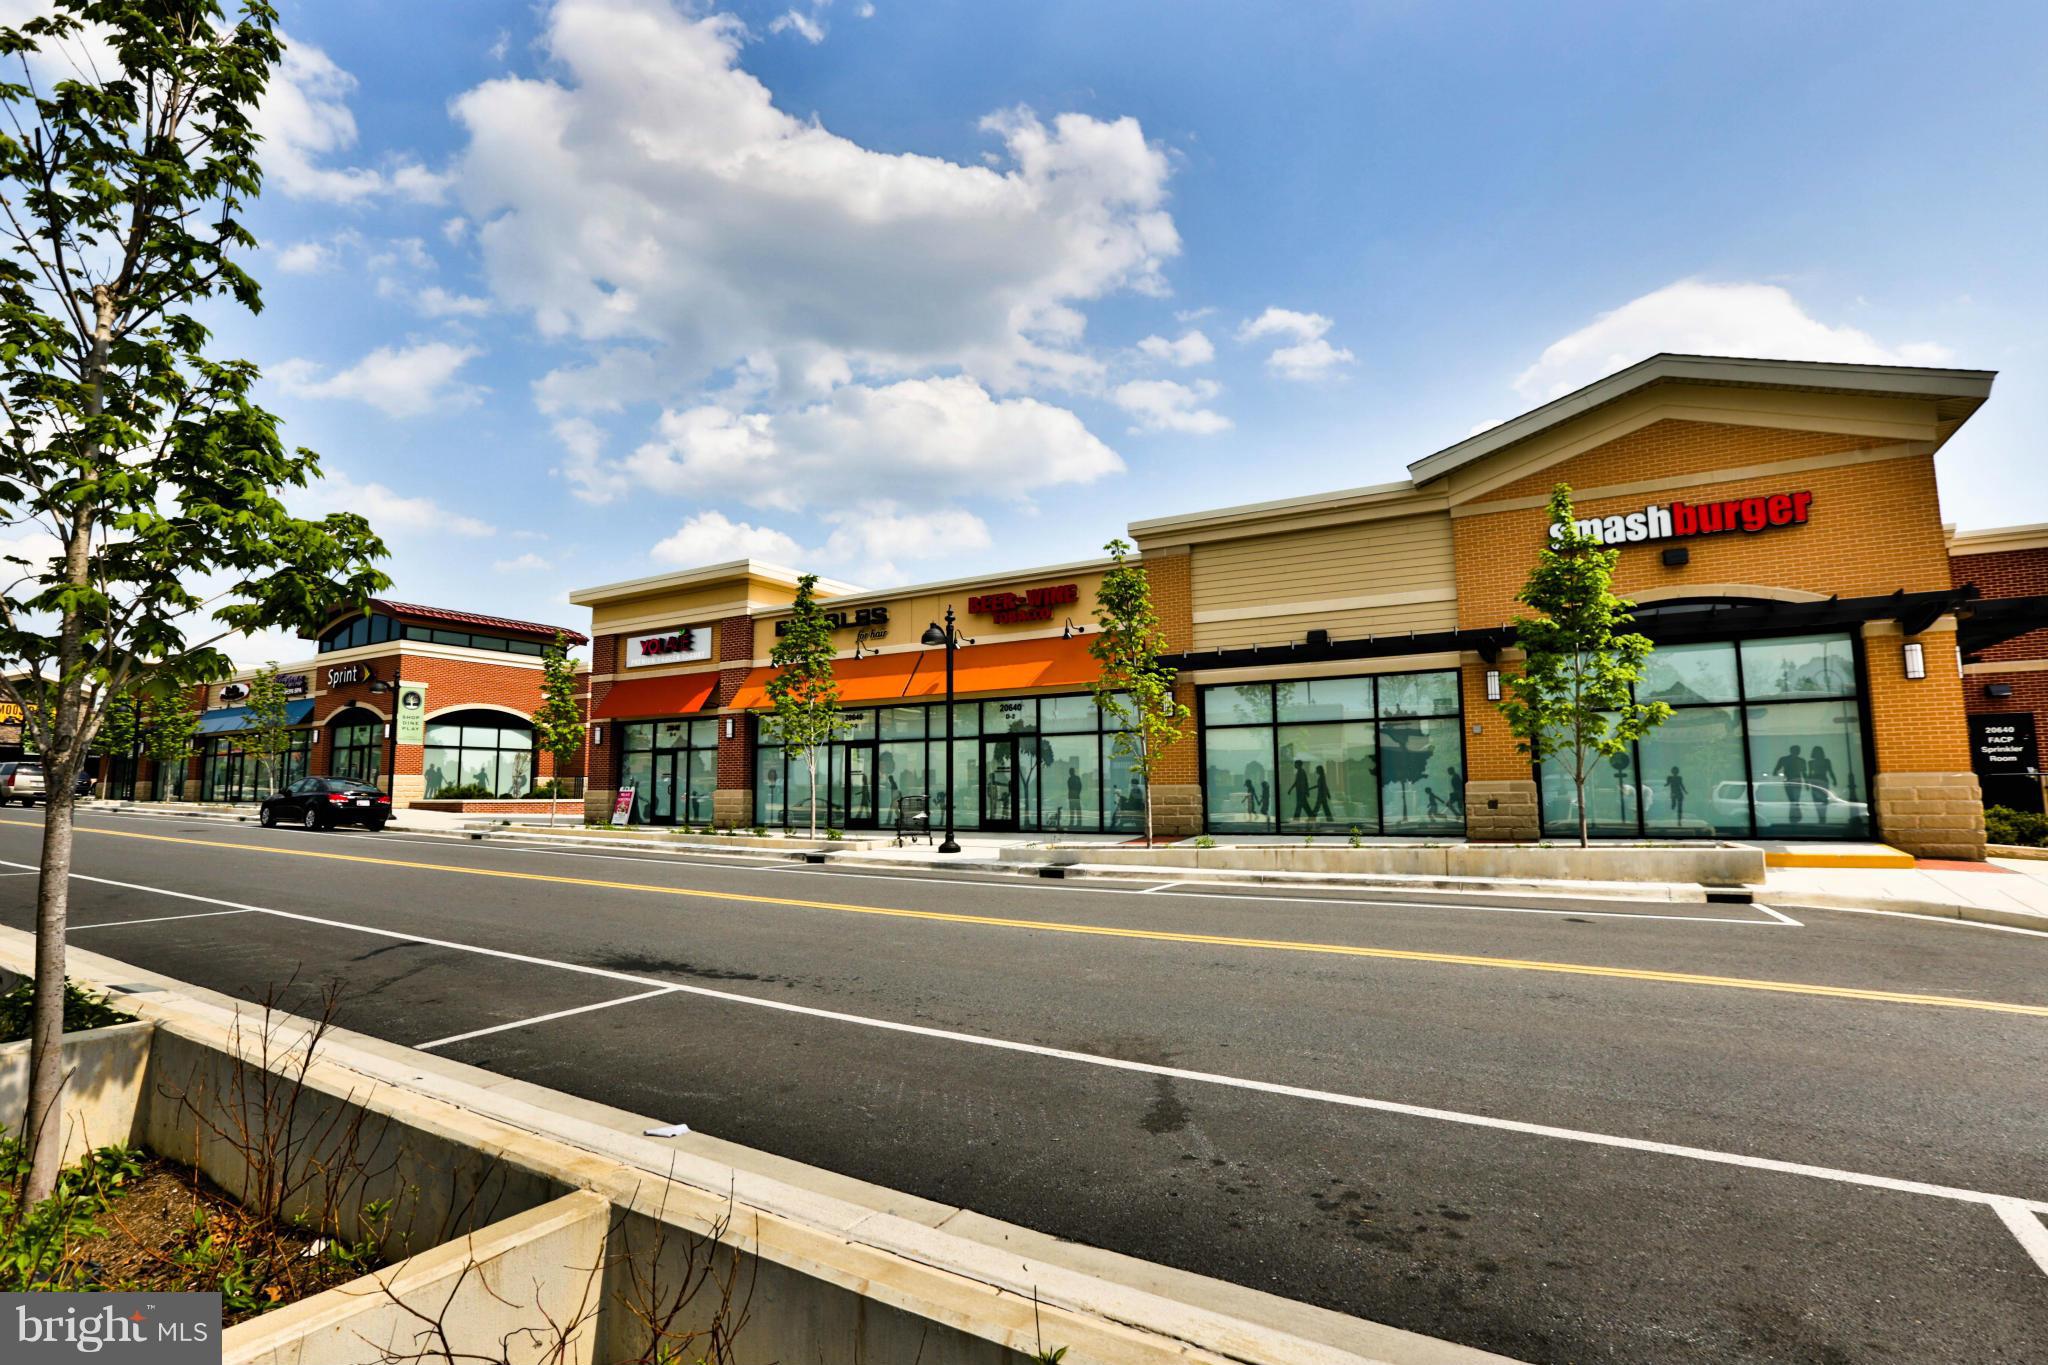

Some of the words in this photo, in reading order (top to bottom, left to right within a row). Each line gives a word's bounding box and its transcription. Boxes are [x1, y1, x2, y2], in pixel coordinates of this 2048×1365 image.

[1549, 490, 1813, 551] smashburger
[775, 607, 888, 637] BBLES
[328, 665, 357, 688] Sprint
[1000, 704, 1022, 712] 20640
[1981, 746, 2024, 754] Sprinkler
